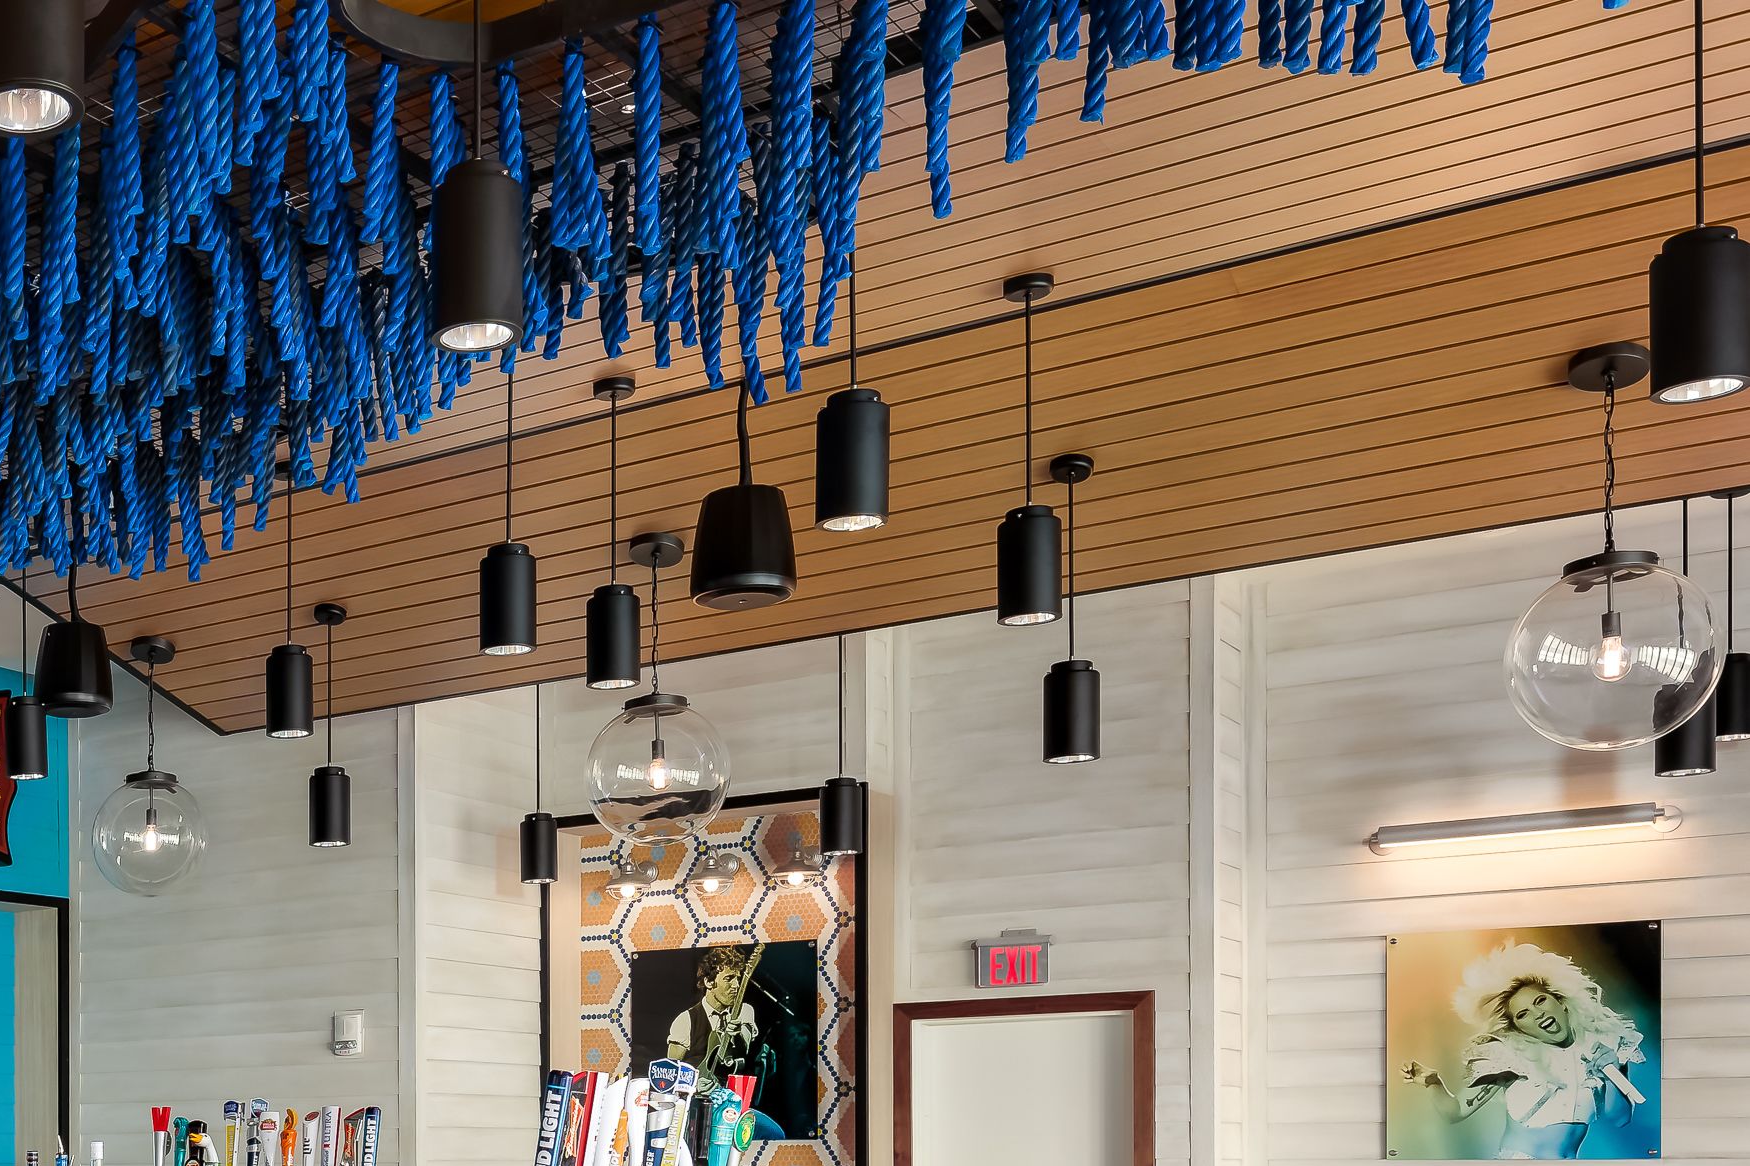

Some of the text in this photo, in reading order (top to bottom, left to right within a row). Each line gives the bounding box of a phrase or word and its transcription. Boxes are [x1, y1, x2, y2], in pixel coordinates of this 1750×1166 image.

[989, 945, 1042, 985] EXIT
[323, 1111, 332, 1142] ULTRA
[365, 1118, 377, 1153] LIGHT
[540, 1090, 562, 1149] LIGHT
